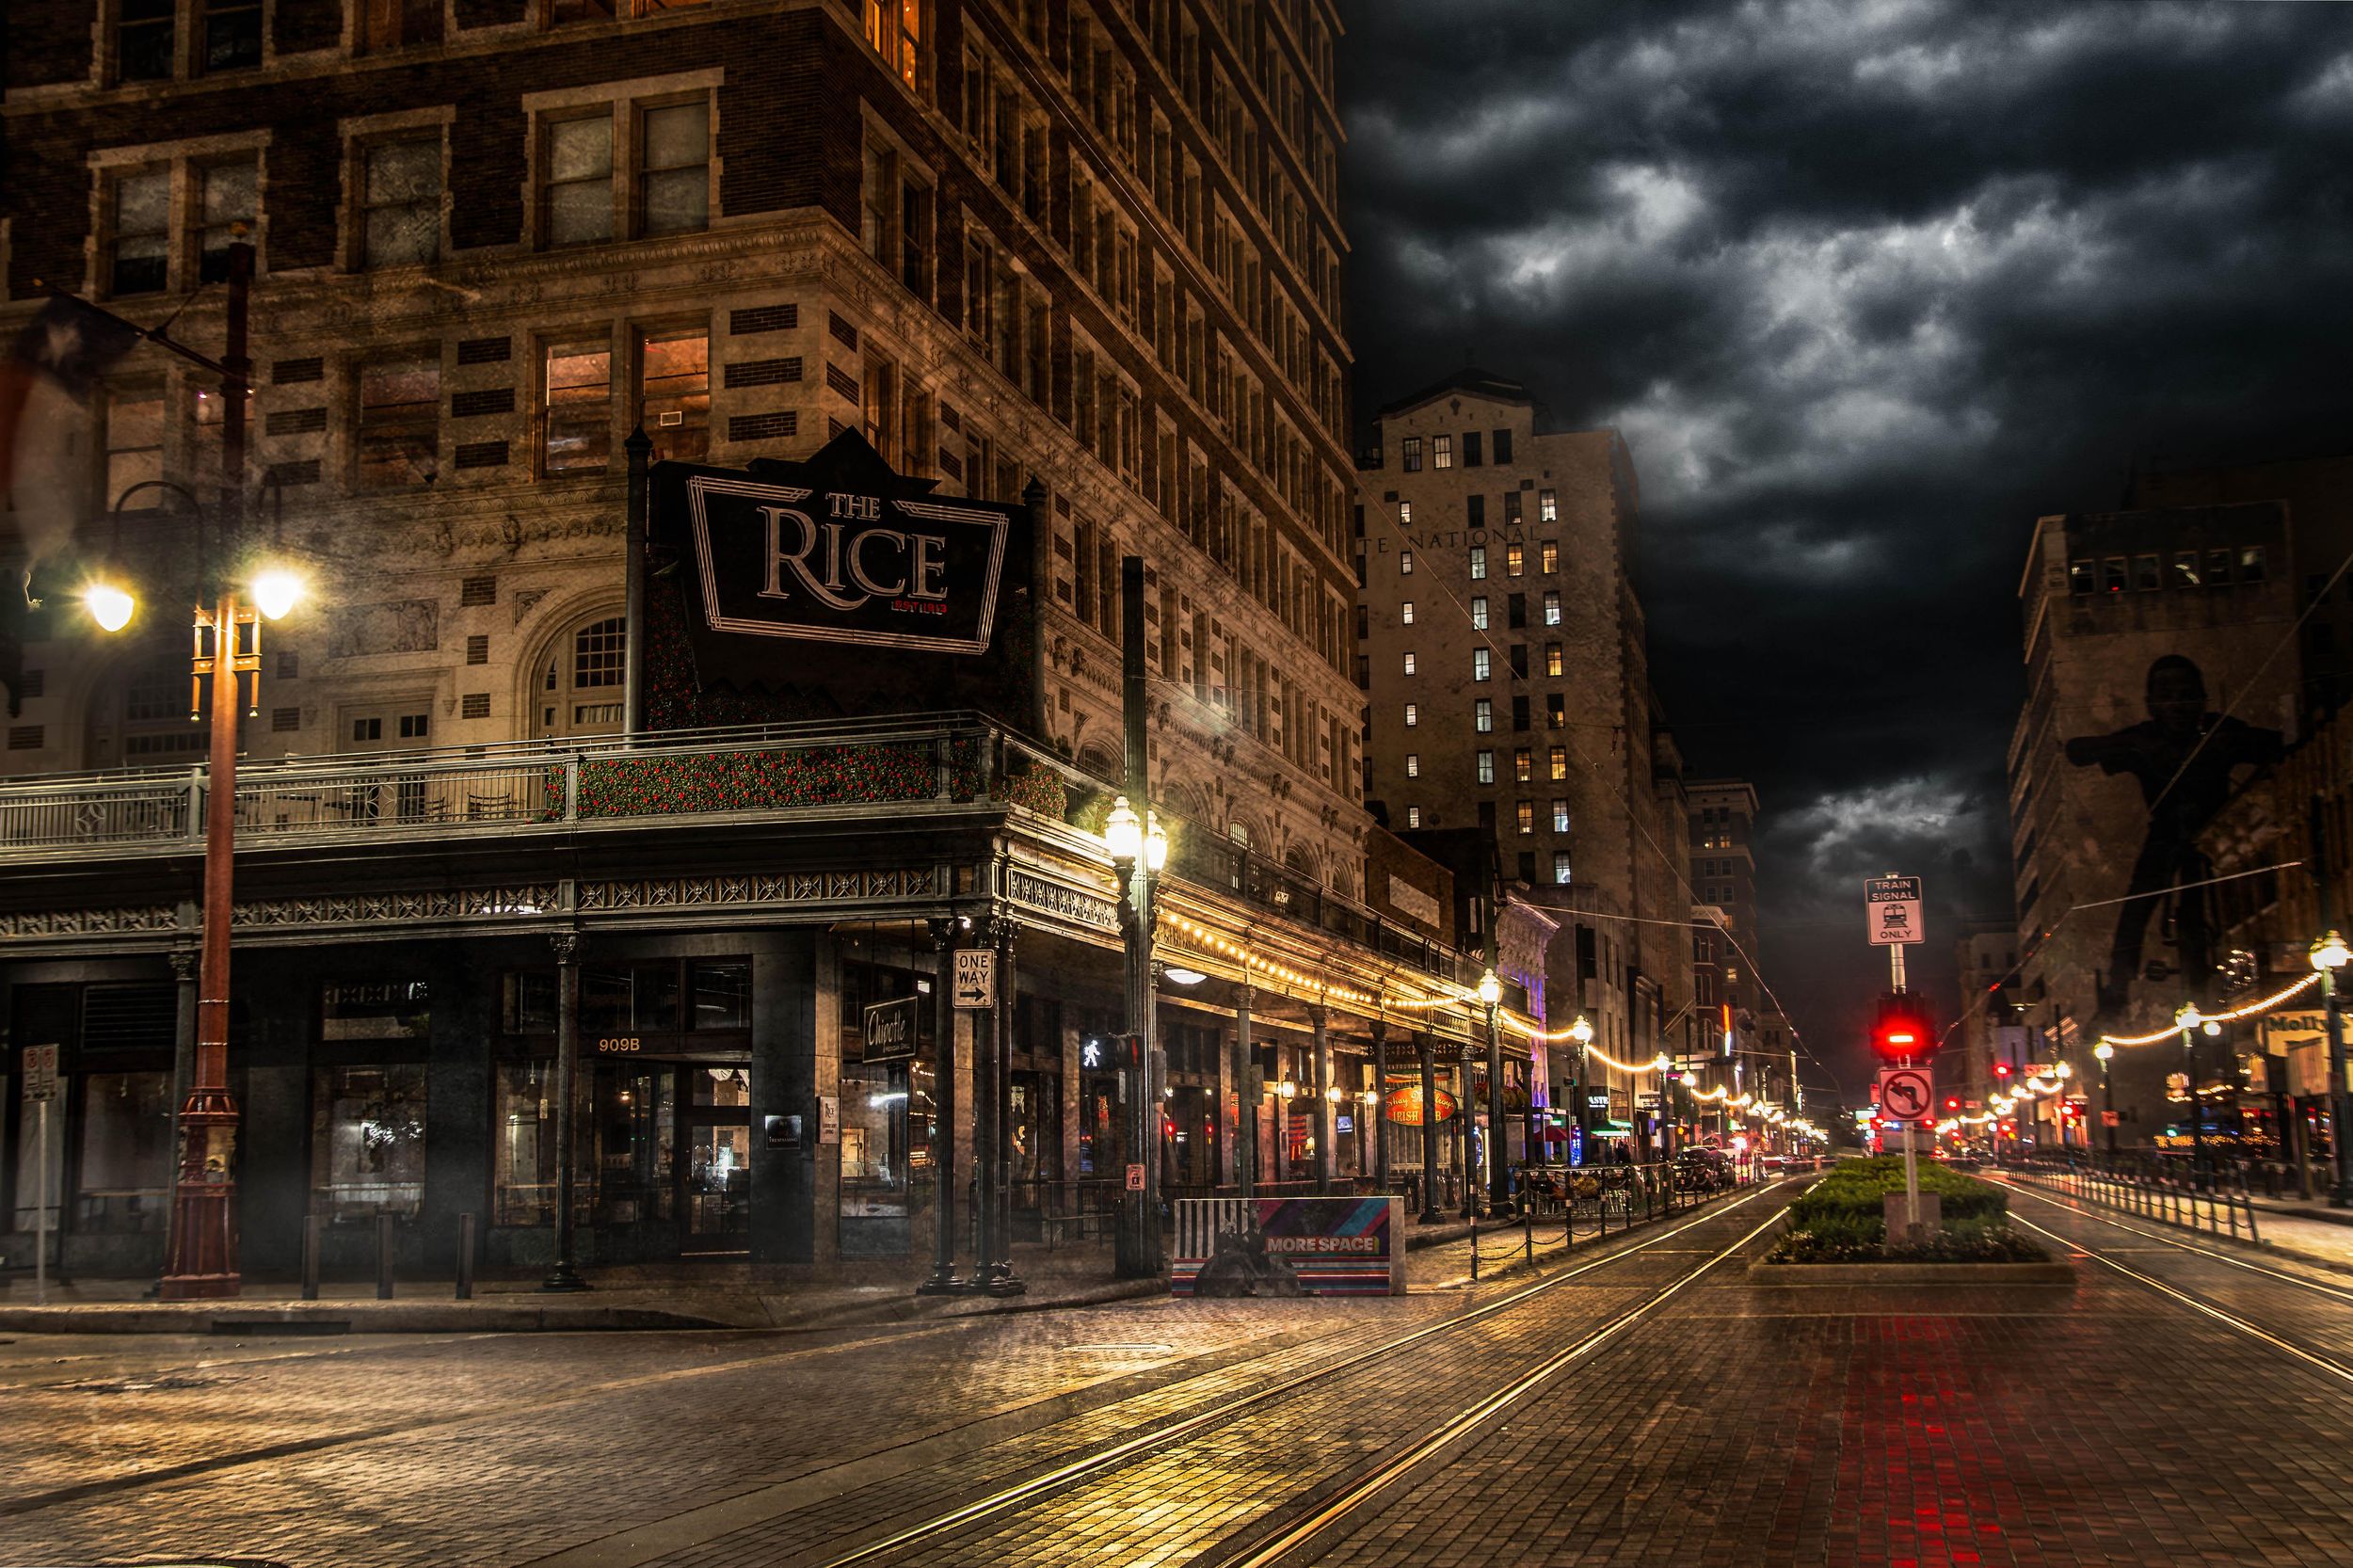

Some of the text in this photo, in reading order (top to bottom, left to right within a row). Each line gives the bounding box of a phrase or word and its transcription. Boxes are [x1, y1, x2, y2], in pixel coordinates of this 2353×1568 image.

[825, 492, 881, 520] THE
[1359, 527, 1541, 553] TE NATIONAL
[757, 505, 948, 611] RICE
[1875, 881, 1911, 889] TRAIN
[1872, 891, 1915, 901] SIGNAL
[1881, 930, 1912, 938] ONLY
[959, 954, 988, 969] ONE
[958, 969, 989, 985] WAY
[868, 1009, 906, 1053] Chipotle
[599, 1038, 640, 1052] 909B
[1393, 1111, 1418, 1122] IRISH
[1268, 1237, 1373, 1252] MORE SPACE
